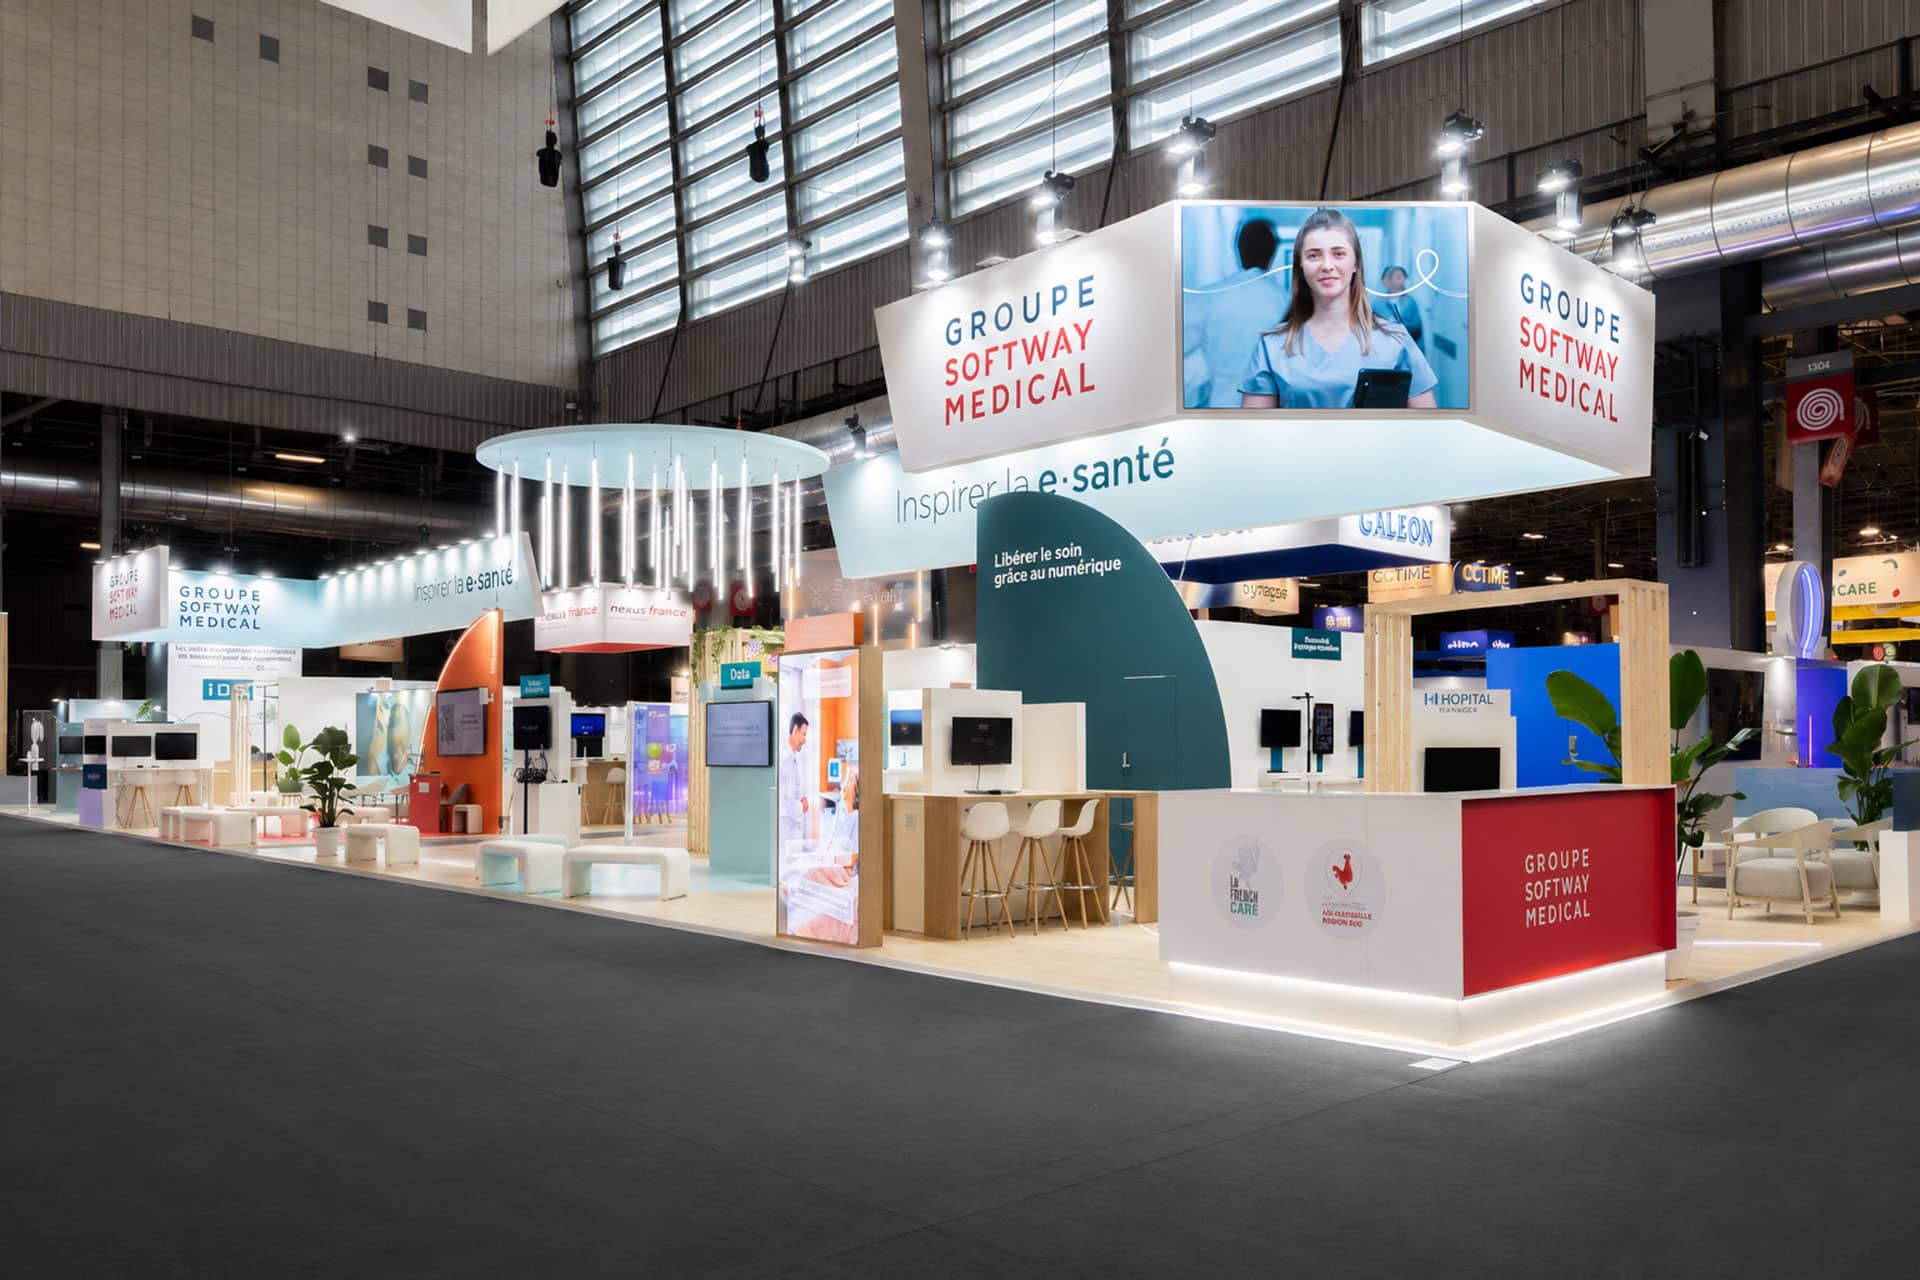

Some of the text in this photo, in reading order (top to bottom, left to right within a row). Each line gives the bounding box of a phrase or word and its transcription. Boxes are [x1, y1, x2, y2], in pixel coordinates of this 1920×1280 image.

[945, 274, 1095, 346] GROUPE
[1520, 273, 1620, 344] GROUPE
[945, 318, 1094, 386] SOFTWAY
[1520, 316, 1618, 382] SOFTWAY
[1808, 360, 1831, 372] 1304
[945, 362, 1095, 426] MEDICAL
[1519, 358, 1618, 423] MEDICAL
[896, 478, 998, 524] Inspirer
[1006, 467, 1029, 493] la
[1359, 510, 1434, 547] GALEON
[994, 542, 1082, 568] Libérer le soin
[1030, 567, 1045, 581] au
[1048, 558, 1122, 579] numérique
[179, 585, 261, 602] GROUPE
[413, 577, 453, 604] Inspirer
[454, 574, 465, 596] la
[179, 600, 261, 616] SOFTWAY
[610, 604, 688, 617] nexus france
[179, 615, 262, 631] MEDICAL
[730, 668, 750, 681] Data
[1525, 848, 1589, 874] GROUPE
[1525, 873, 1589, 901] SOFTWAY
[1230, 902, 1259, 916] CARE
[1526, 899, 1590, 928] MEDICAL
